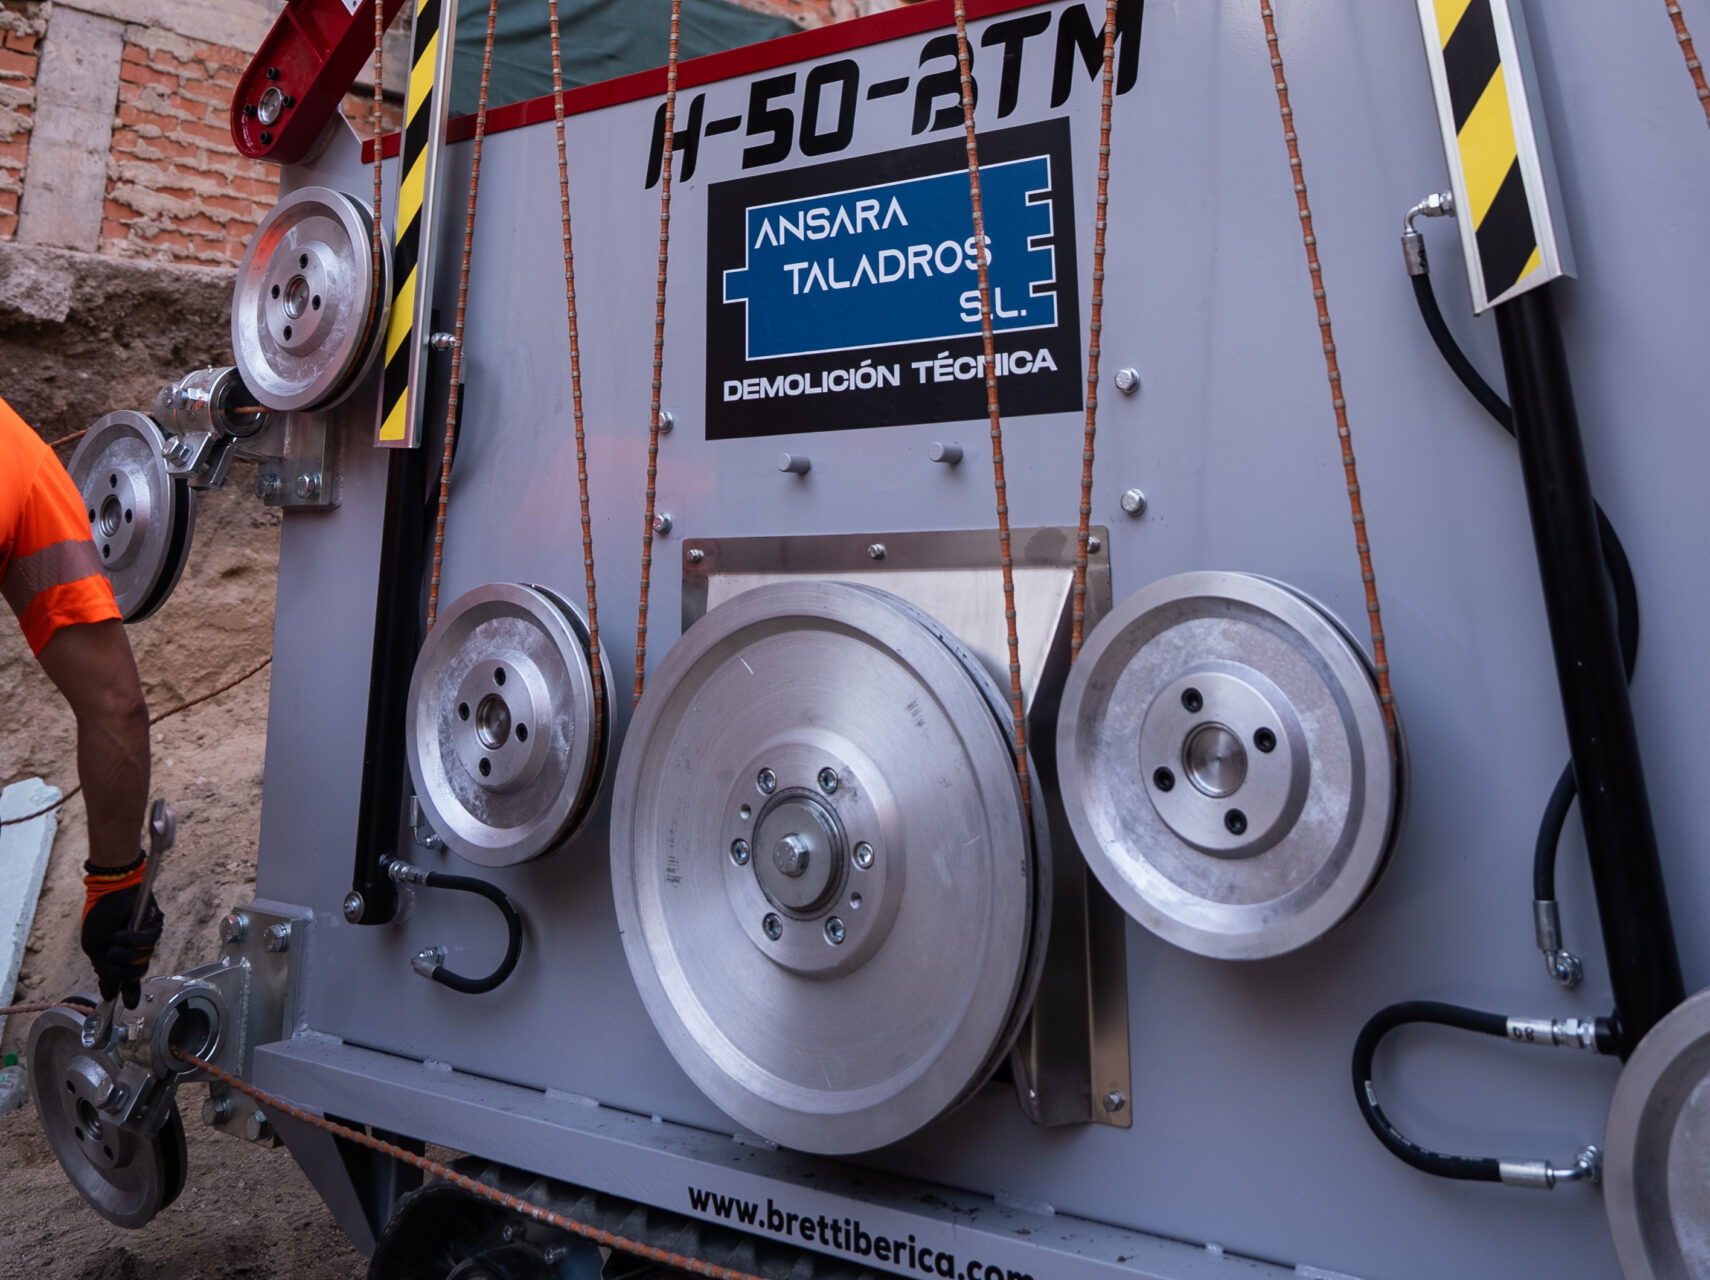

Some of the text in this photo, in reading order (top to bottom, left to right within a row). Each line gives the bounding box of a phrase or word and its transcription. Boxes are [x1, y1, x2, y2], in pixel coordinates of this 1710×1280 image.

[755, 196, 908, 249] ANSARA
[784, 235, 992, 295] TALADROS
[724, 348, 1057, 401] DEMOLICIÓN TÉCNICA
